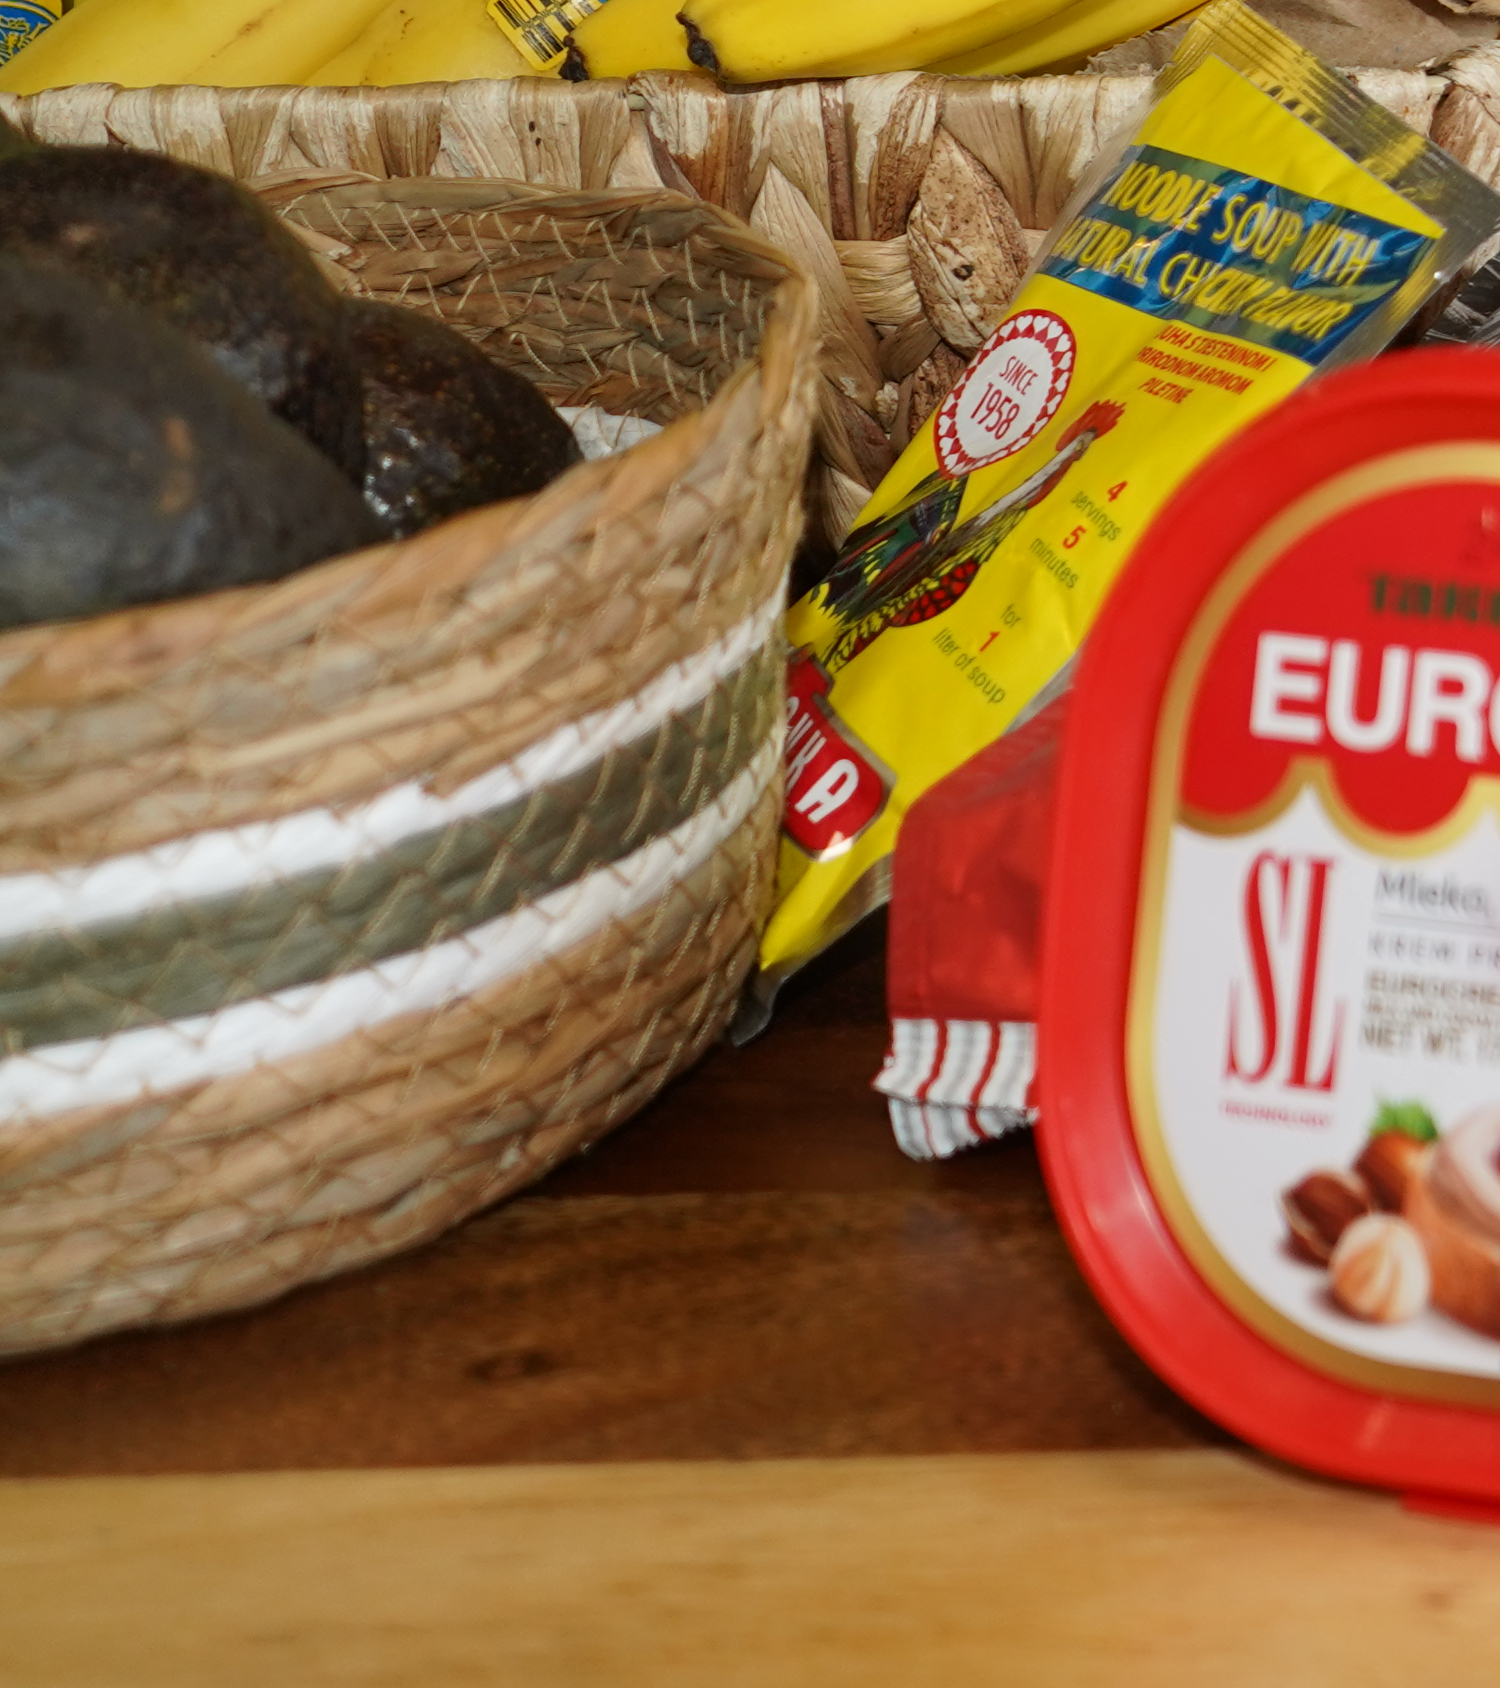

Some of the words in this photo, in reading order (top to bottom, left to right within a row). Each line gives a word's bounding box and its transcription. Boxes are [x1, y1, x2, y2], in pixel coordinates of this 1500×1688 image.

[1099, 159, 1224, 235] NOODLE
[1212, 193, 1303, 264] SOUP
[1292, 220, 1382, 288] WITH
[1000, 355, 1039, 396] SINCE
[970, 382, 1023, 442] 1958
[1106, 480, 1129, 503] 4
[1062, 524, 1088, 551] 5
[1070, 489, 1123, 543] servings
[1028, 535, 1081, 590] minutes
[1000, 603, 1022, 630] for
[978, 630, 1002, 653] 1
[931, 626, 957, 657] liter
[953, 652, 975, 671] of
[967, 666, 1007, 706] soup
